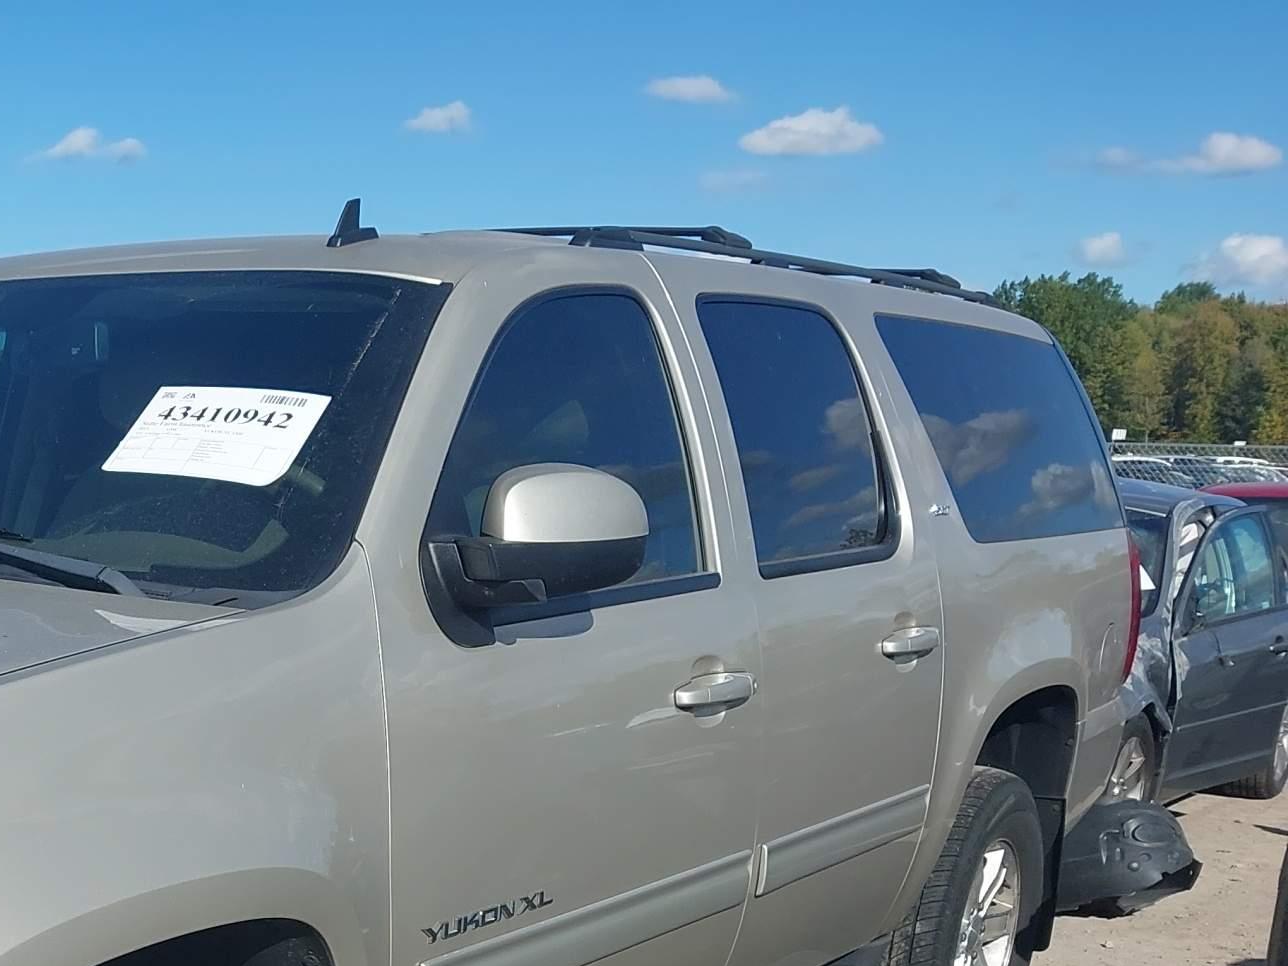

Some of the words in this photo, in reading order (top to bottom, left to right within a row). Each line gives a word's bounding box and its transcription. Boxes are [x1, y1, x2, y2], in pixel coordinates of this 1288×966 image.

[158, 405, 294, 429] 43410942
[421, 899, 516, 944] YUKON
[517, 890, 553, 915] XL
